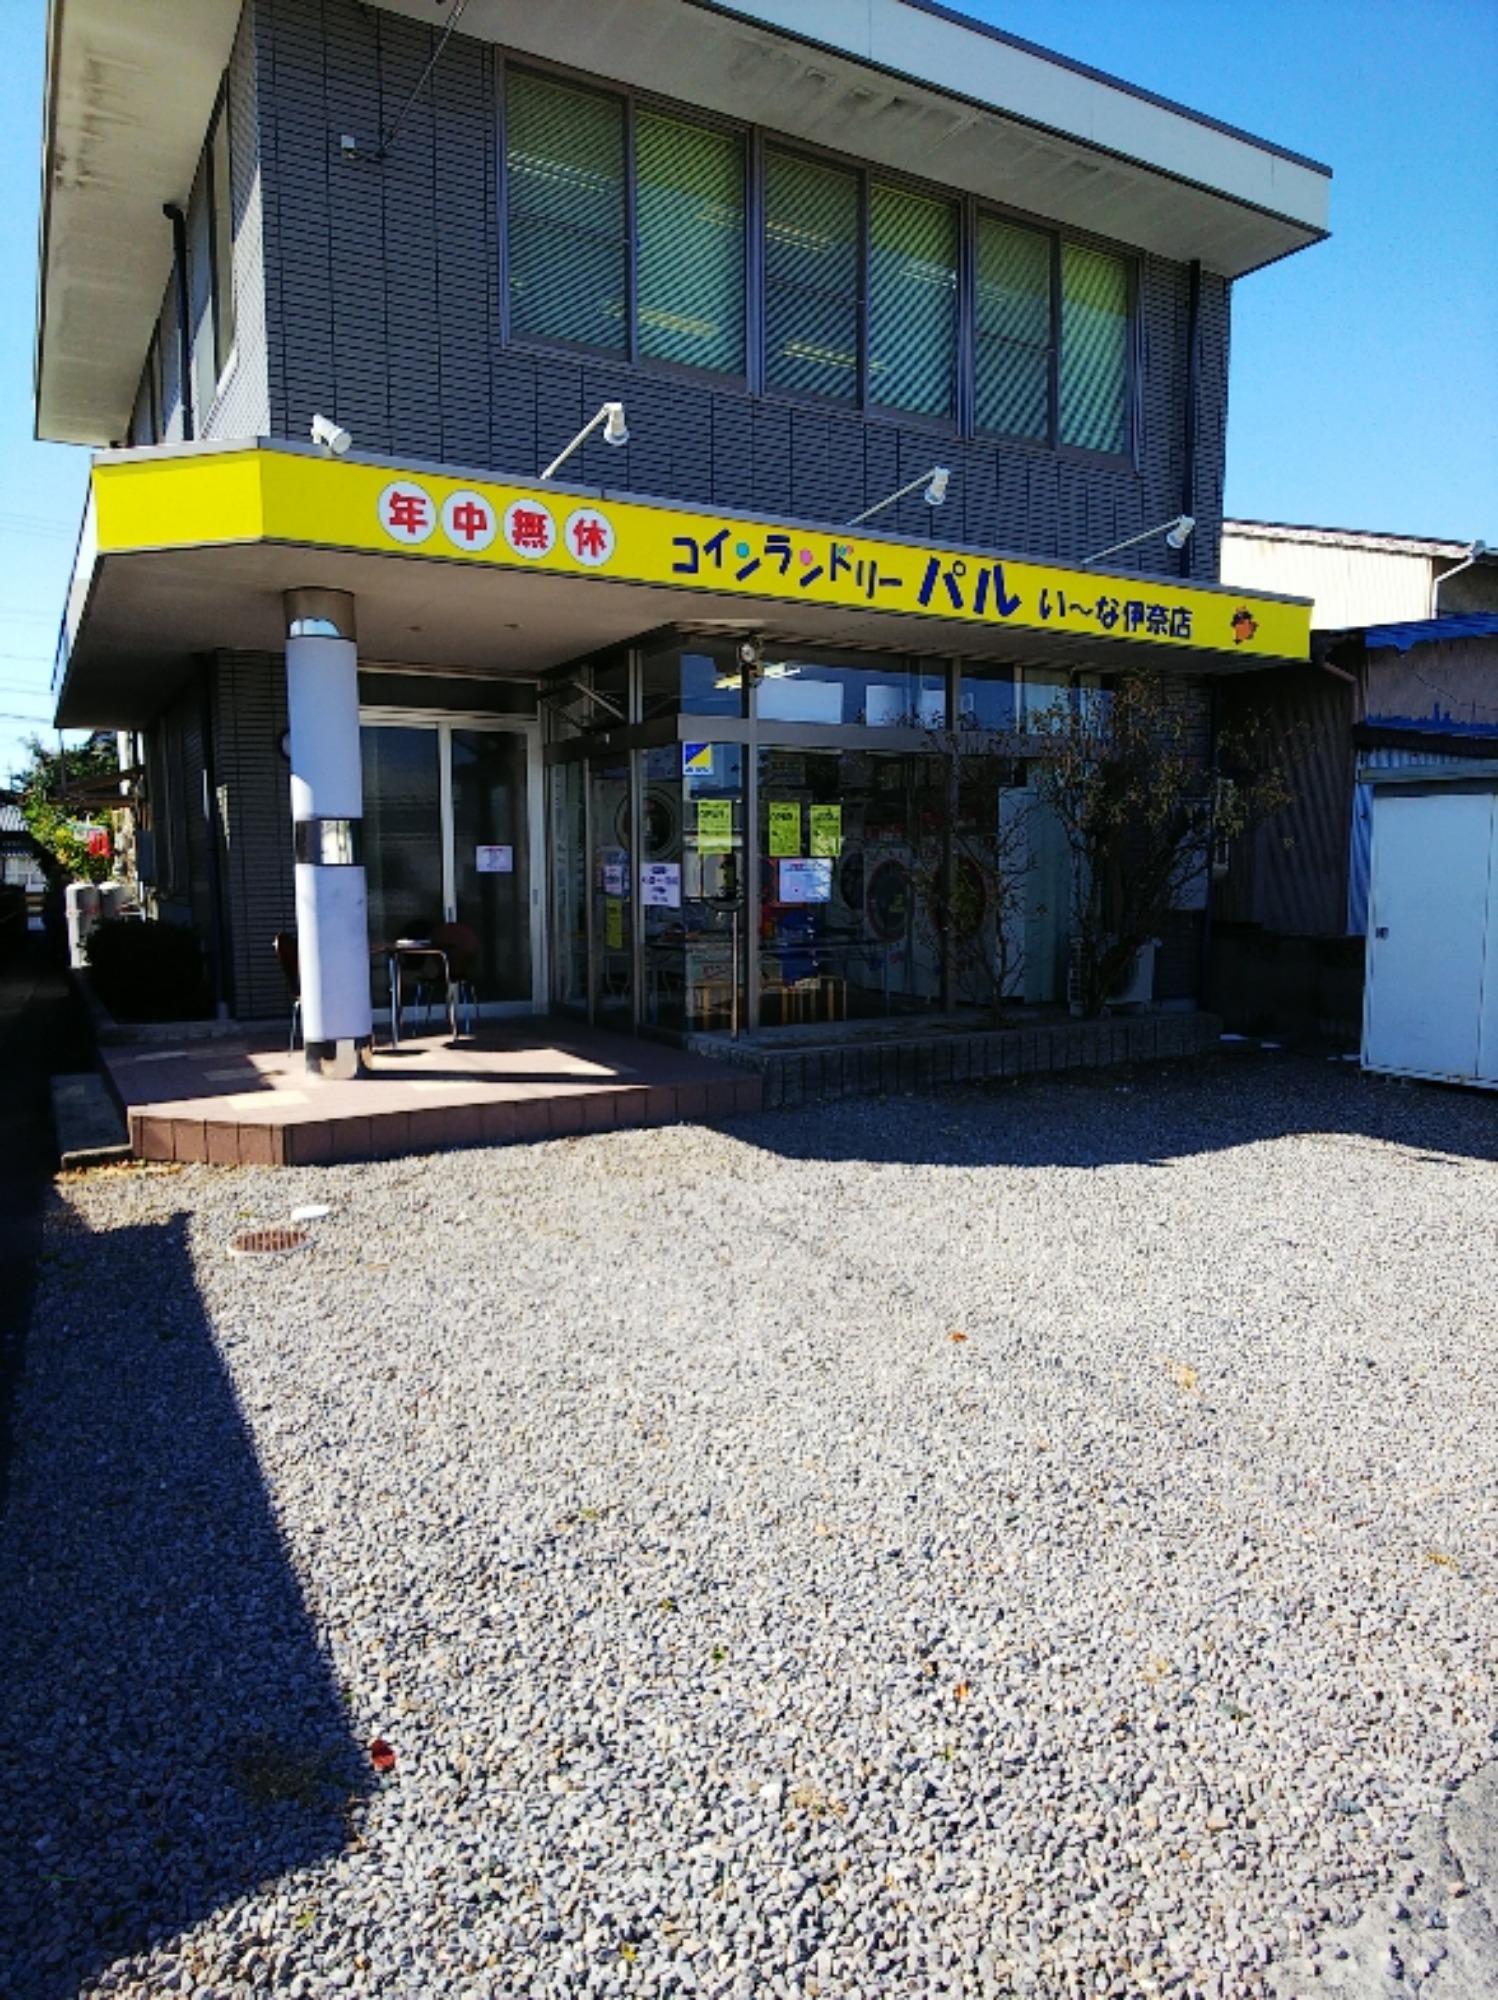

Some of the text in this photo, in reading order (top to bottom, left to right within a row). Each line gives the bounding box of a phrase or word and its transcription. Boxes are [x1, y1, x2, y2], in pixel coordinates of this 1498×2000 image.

[389, 491, 607, 558] 年中無休
[672, 530, 903, 598] コインランドリー
[917, 557, 1021, 617] パル
